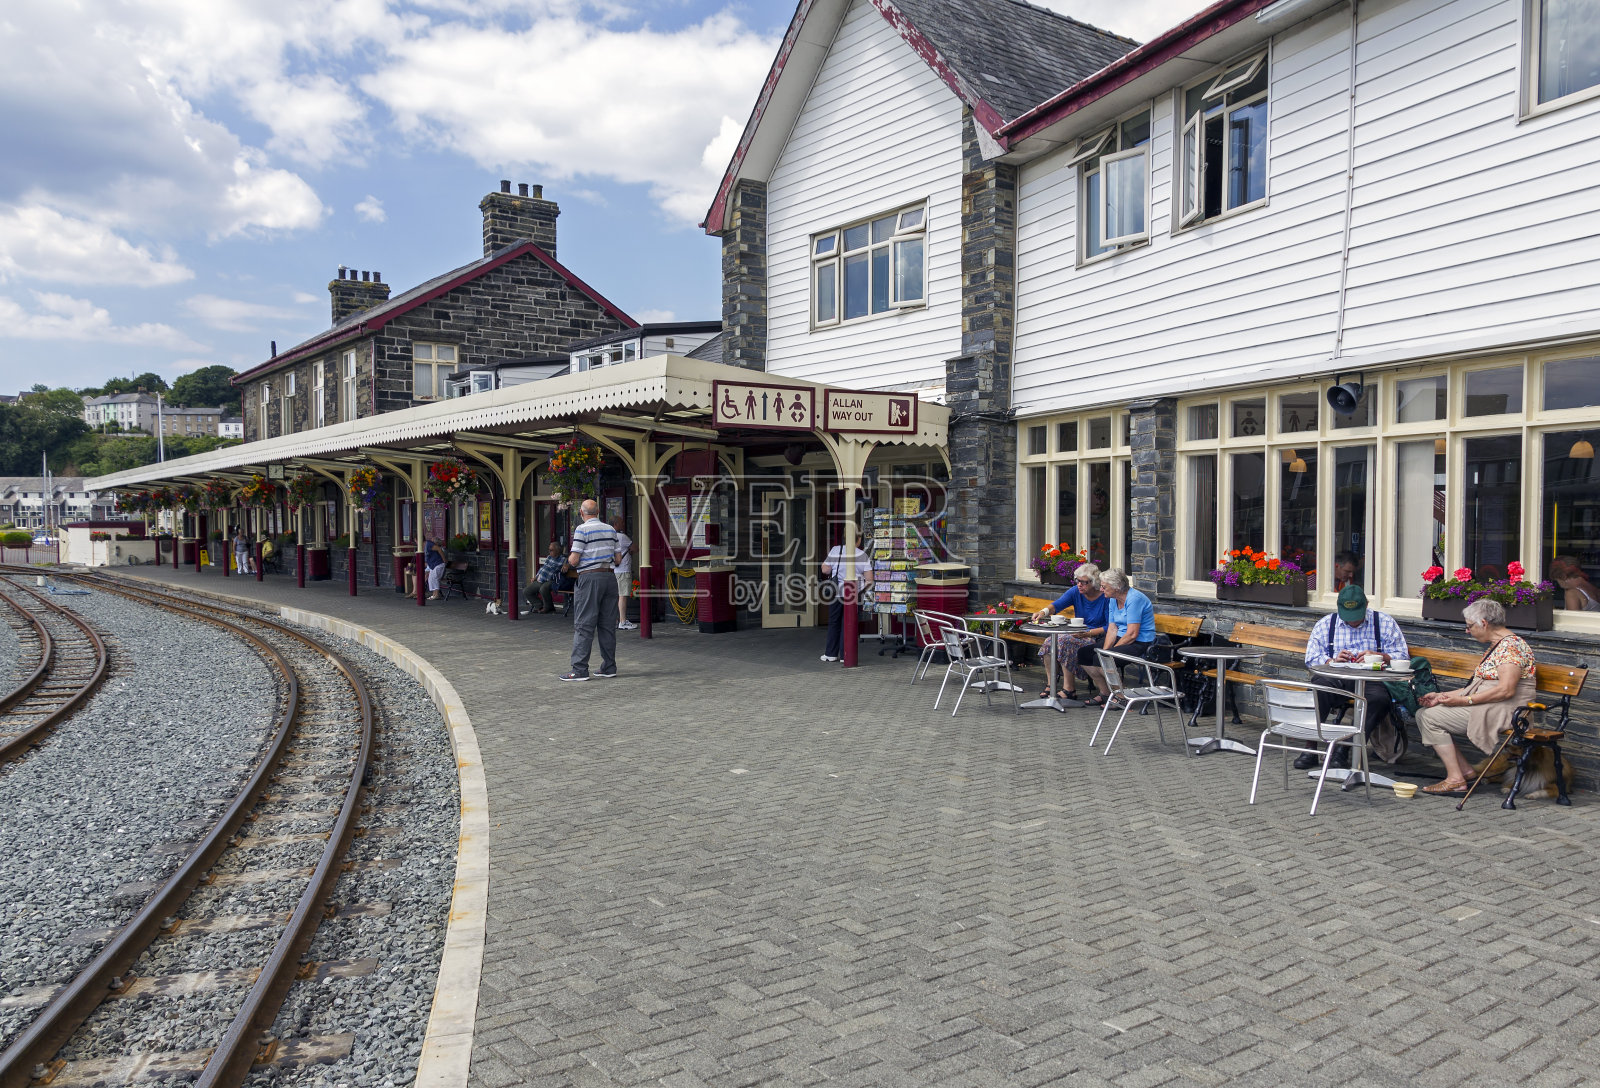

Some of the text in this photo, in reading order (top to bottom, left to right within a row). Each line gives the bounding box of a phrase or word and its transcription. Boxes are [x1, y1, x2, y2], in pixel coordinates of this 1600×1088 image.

[832, 398, 863, 408] ALLAN
[832, 411, 873, 421] WAY OUT
